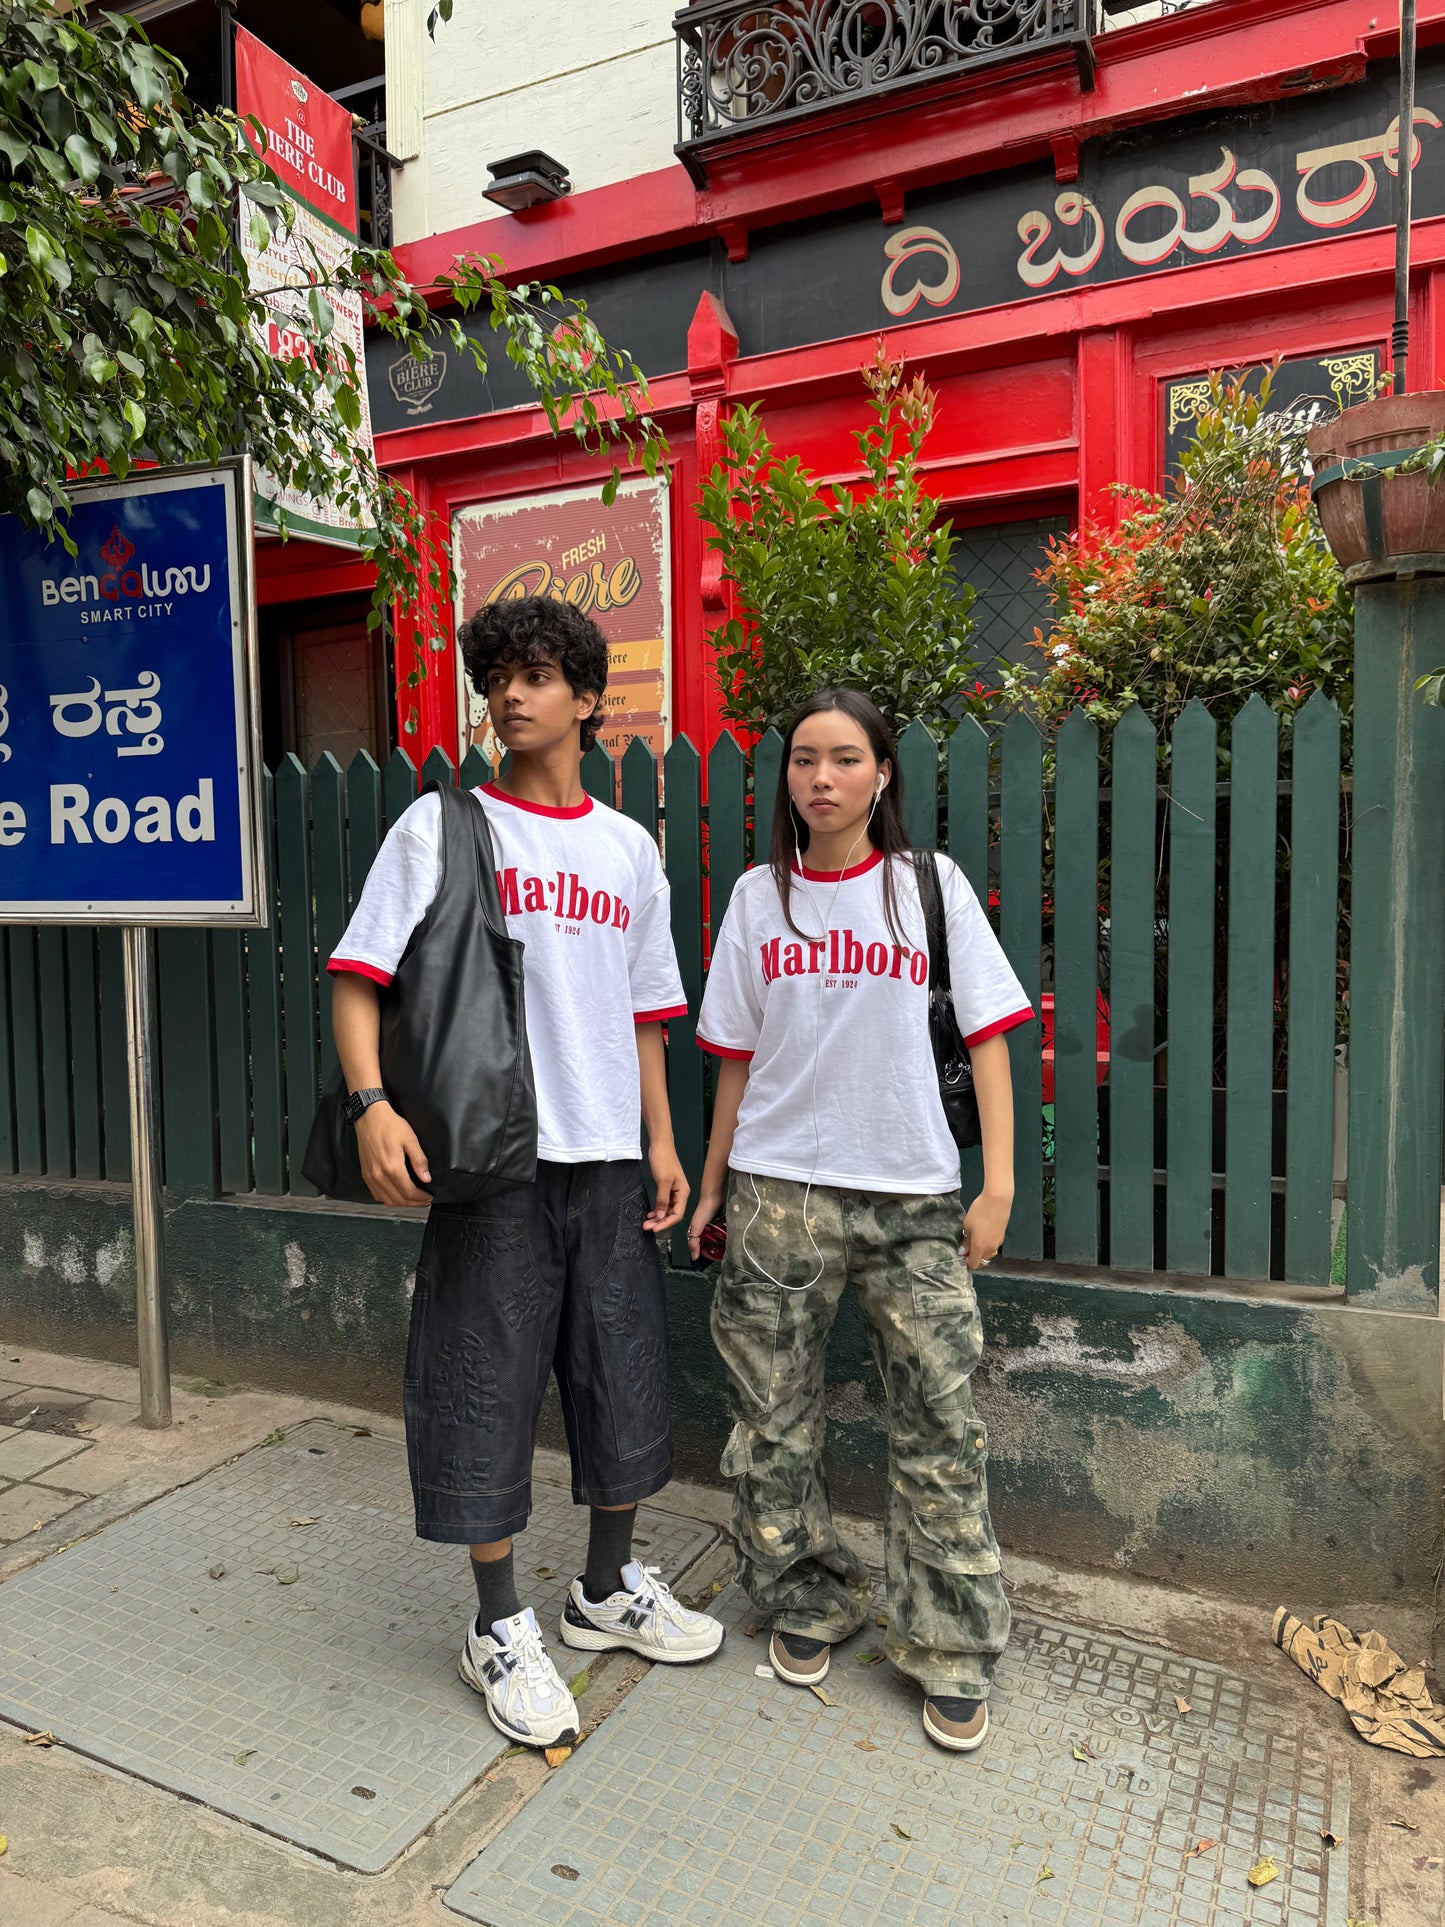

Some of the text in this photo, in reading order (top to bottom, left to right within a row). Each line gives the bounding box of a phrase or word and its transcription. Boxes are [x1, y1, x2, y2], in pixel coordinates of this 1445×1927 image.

[285, 117, 315, 159] THE
[308, 161, 346, 203] CLUB
[244, 237, 289, 264] LIFSTYLE
[397, 363, 439, 386] BIERE
[404, 376, 432, 393] CLUB
[561, 532, 606, 571] FRESH
[80, 602, 173, 624] SMART CITY
[606, 652, 628, 665] iere
[50, 778, 216, 846] Road
[564, 924, 581, 936] 1924
[760, 929, 928, 986] Marlboro
[825, 979, 858, 989] EST 1924
[1082, 1698, 1231, 1752] COVER
[1074, 1760, 1160, 1799] LTD
